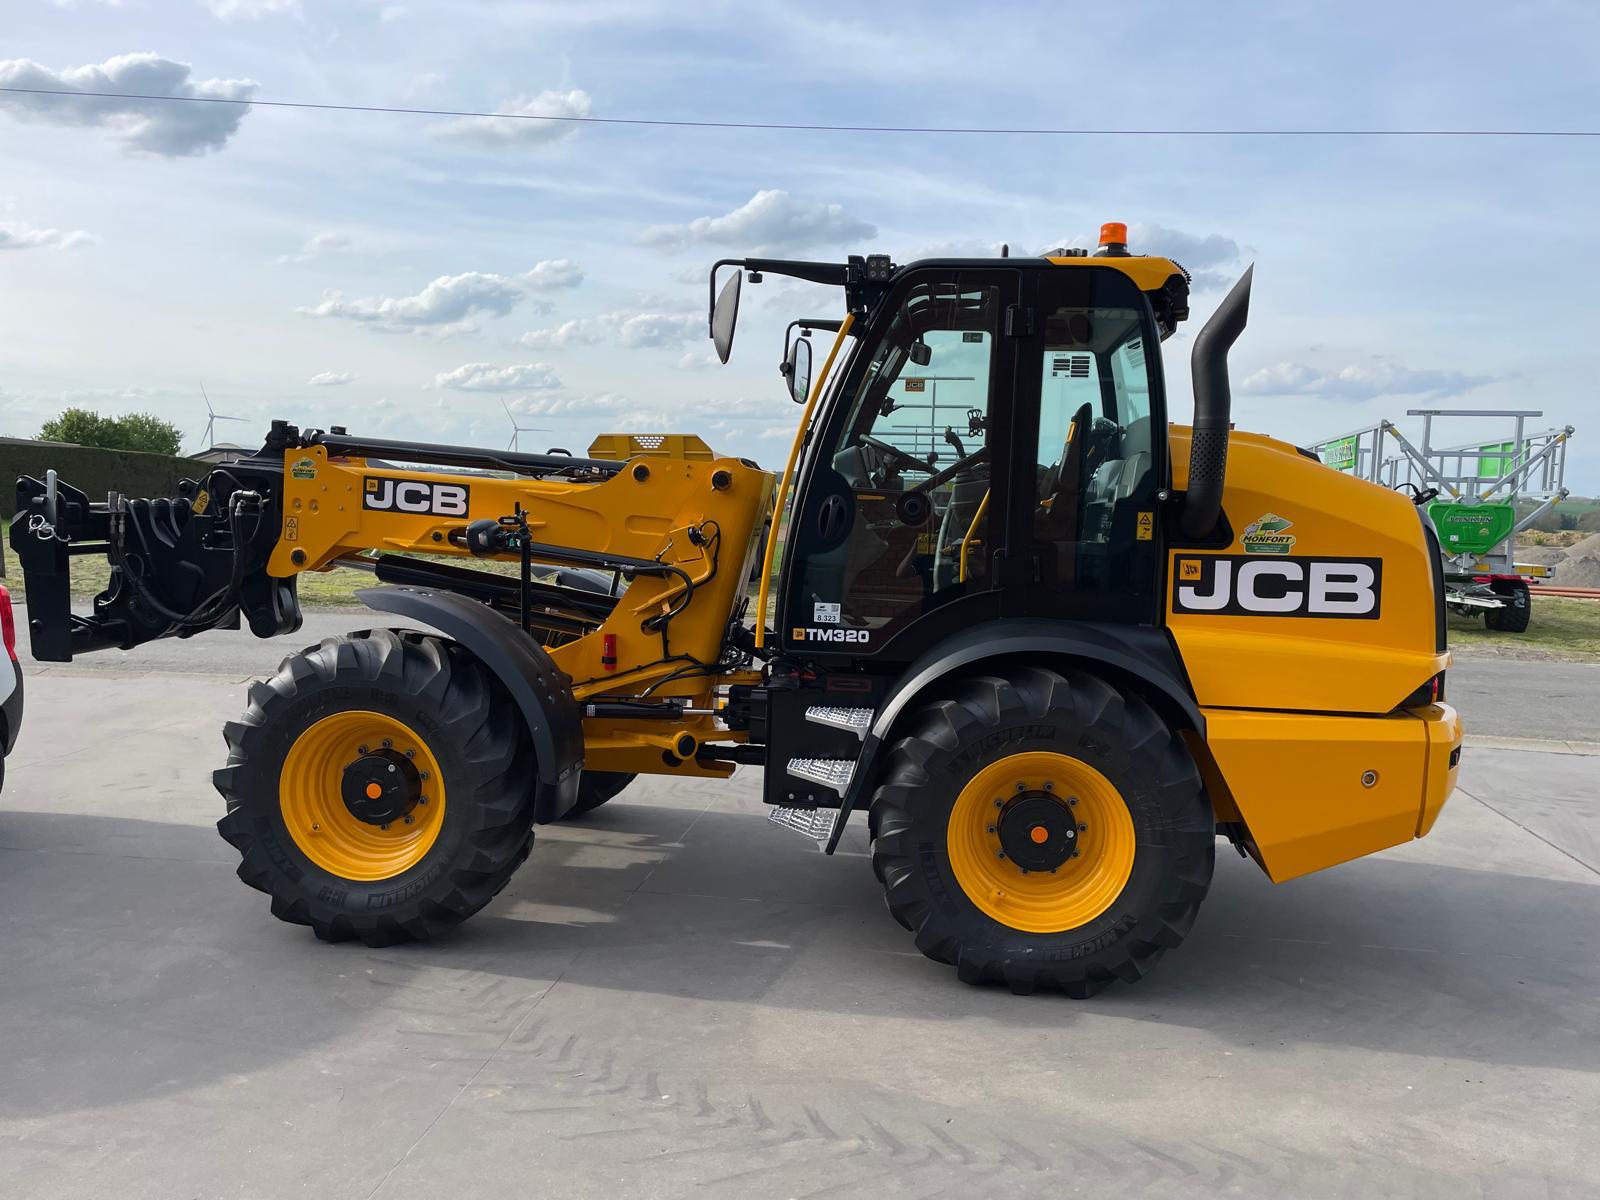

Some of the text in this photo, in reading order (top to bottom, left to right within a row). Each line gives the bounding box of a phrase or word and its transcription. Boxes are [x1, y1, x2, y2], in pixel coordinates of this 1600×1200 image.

[365, 480, 467, 516] JCB
[1243, 535, 1292, 543] MONFORT
[1178, 560, 1376, 614] JCB
[817, 614, 837, 622] 8.323
[806, 628, 870, 643] TM320
